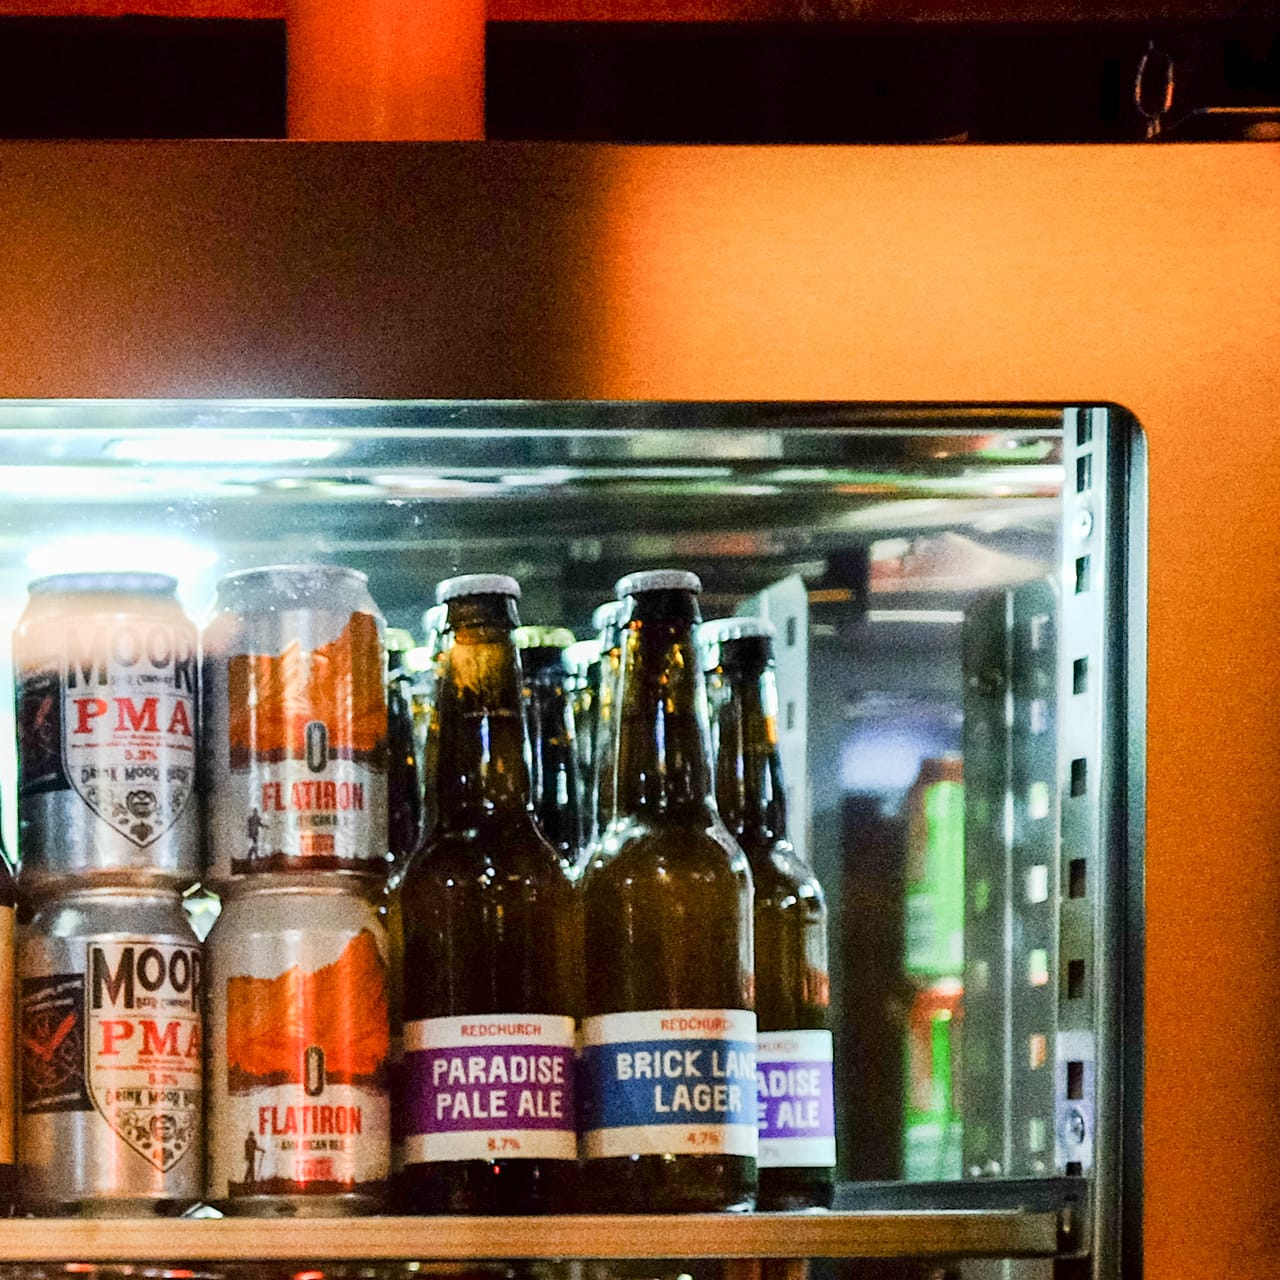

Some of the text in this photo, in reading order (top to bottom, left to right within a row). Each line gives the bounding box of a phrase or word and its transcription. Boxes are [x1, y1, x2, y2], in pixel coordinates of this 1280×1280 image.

[72, 697, 193, 736] PMA
[262, 780, 364, 813] FLATIRON
[98, 1020, 200, 1058] PMA
[461, 1023, 542, 1037] REDCHURCH
[433, 1055, 565, 1087] PARADISE
[616, 1049, 702, 1081] BRICK
[653, 1083, 743, 1113] LAGER
[757, 1067, 821, 1098] ADISE
[258, 1104, 362, 1136] FLATIRON
[436, 1090, 563, 1121] PALE ALE
[776, 1101, 820, 1130] ALE
